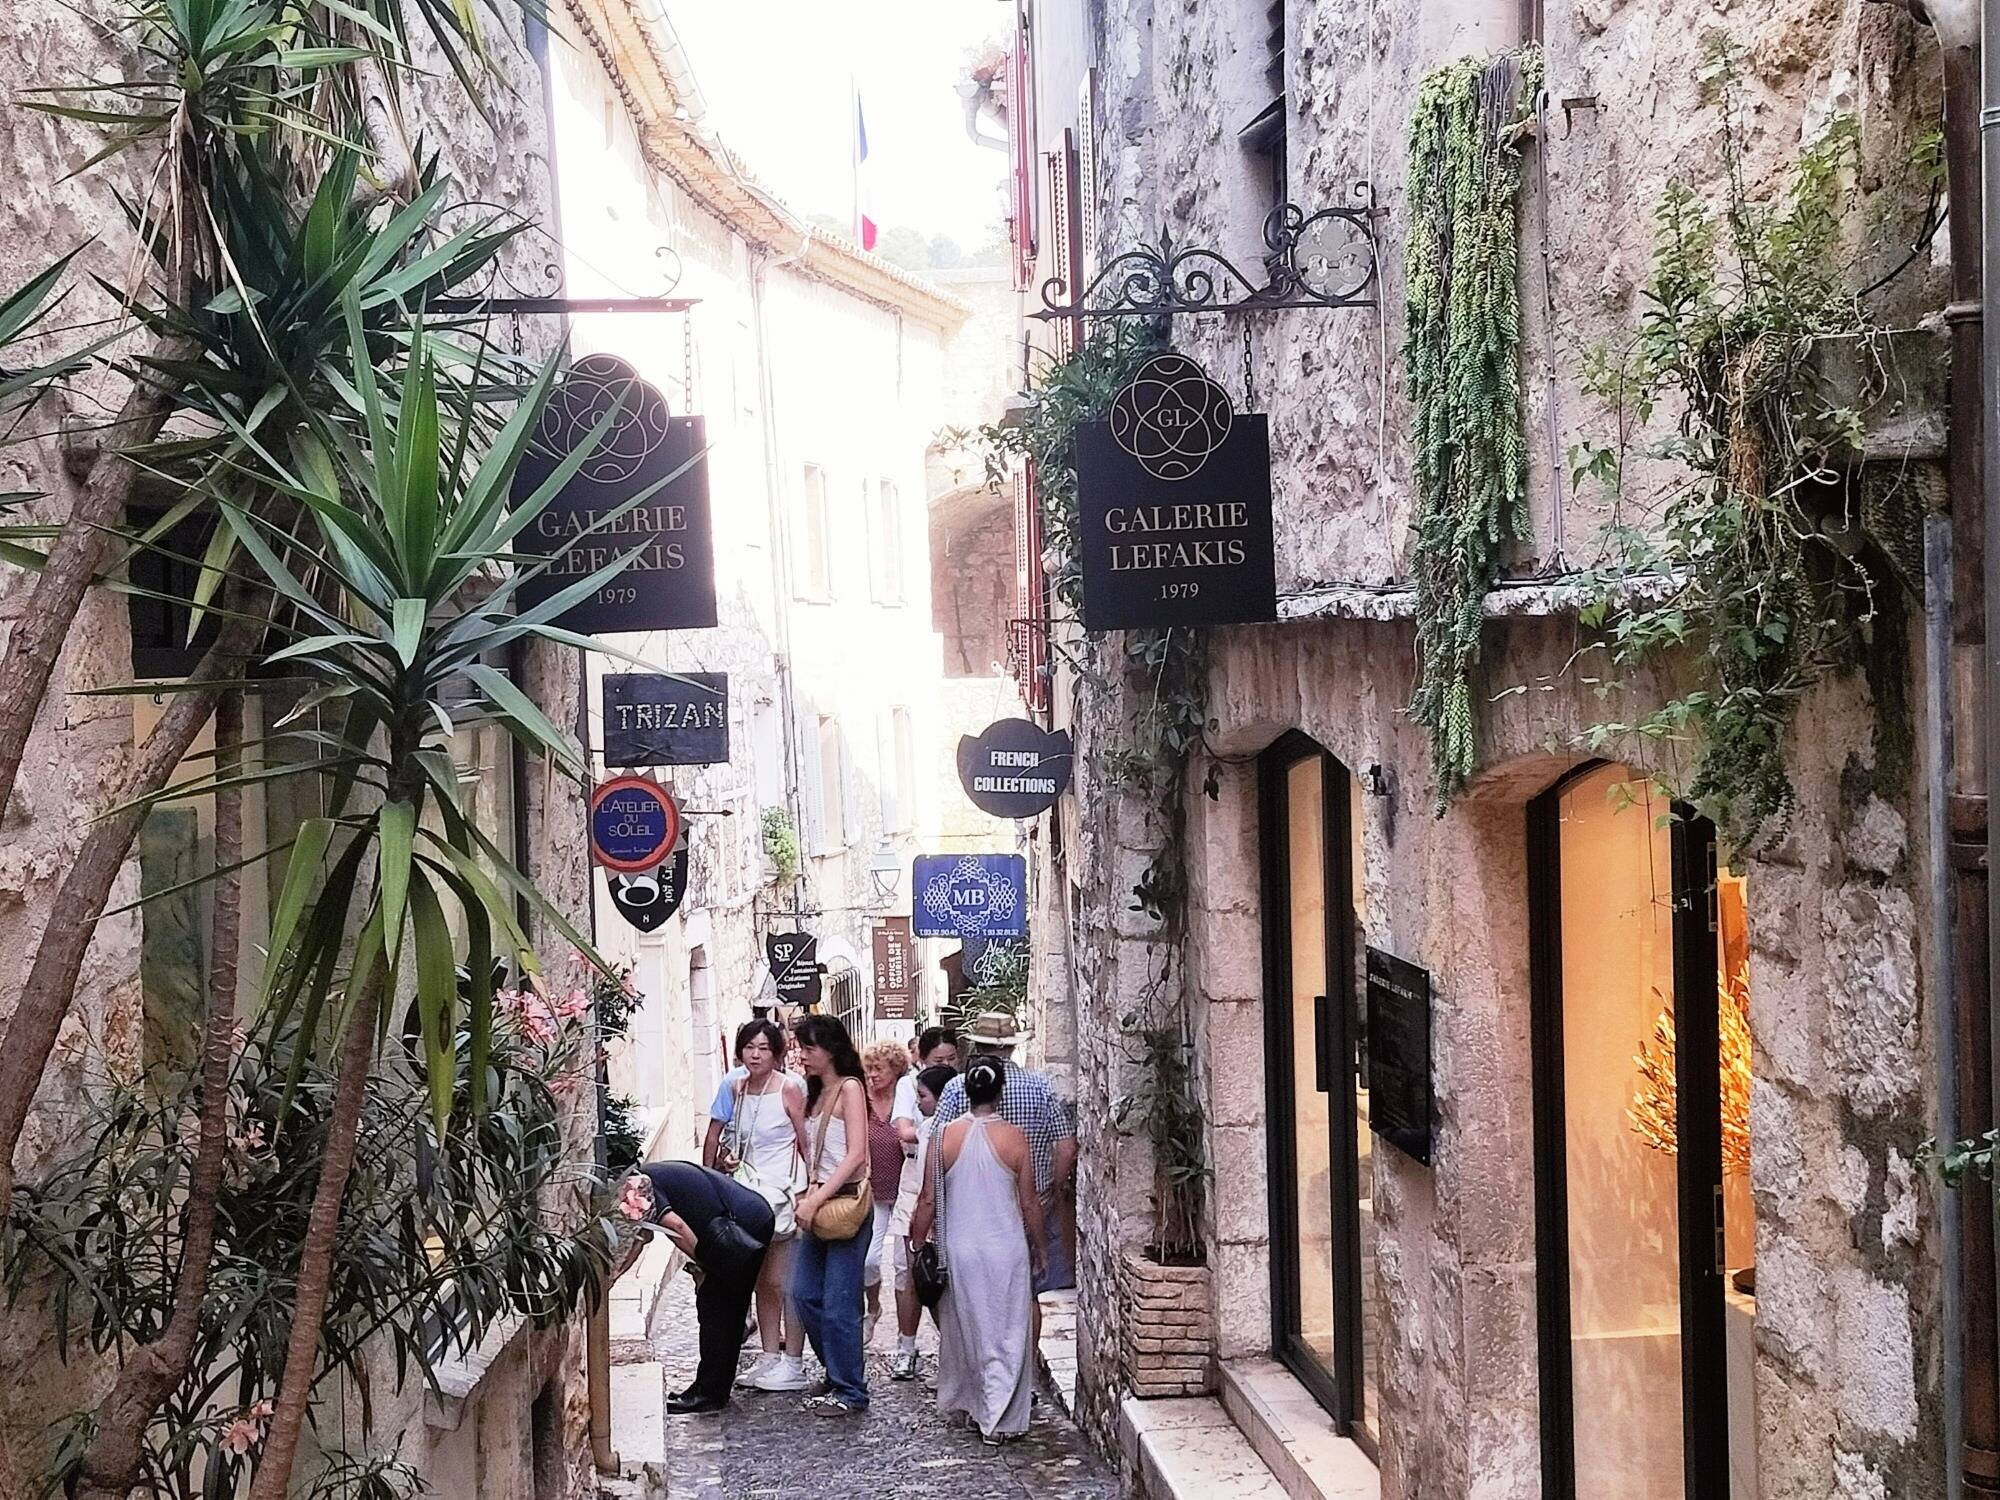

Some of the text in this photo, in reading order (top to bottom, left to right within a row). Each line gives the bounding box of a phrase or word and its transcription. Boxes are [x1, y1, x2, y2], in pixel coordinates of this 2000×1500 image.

[1157, 408, 1189, 428] GL
[537, 505, 688, 538] GALERIE
[1104, 502, 1248, 534] GALERIE
[1109, 539, 1246, 571] LEFAKIS
[597, 587, 637, 605] 1979
[1160, 582, 1200, 599] 1979
[615, 702, 724, 729] TRIZAN
[990, 750, 1039, 767] FRENCH
[973, 776, 1056, 793] COLLECTIONS
[601, 800, 660, 814] L'ATELIER
[623, 814, 639, 823] DU
[608, 823, 655, 837] SOLEIL
[952, 888, 985, 906] MB
[774, 943, 794, 959] SP
[888, 942, 896, 989] OFFICE DE
[895, 942, 903, 989] TOURISME
